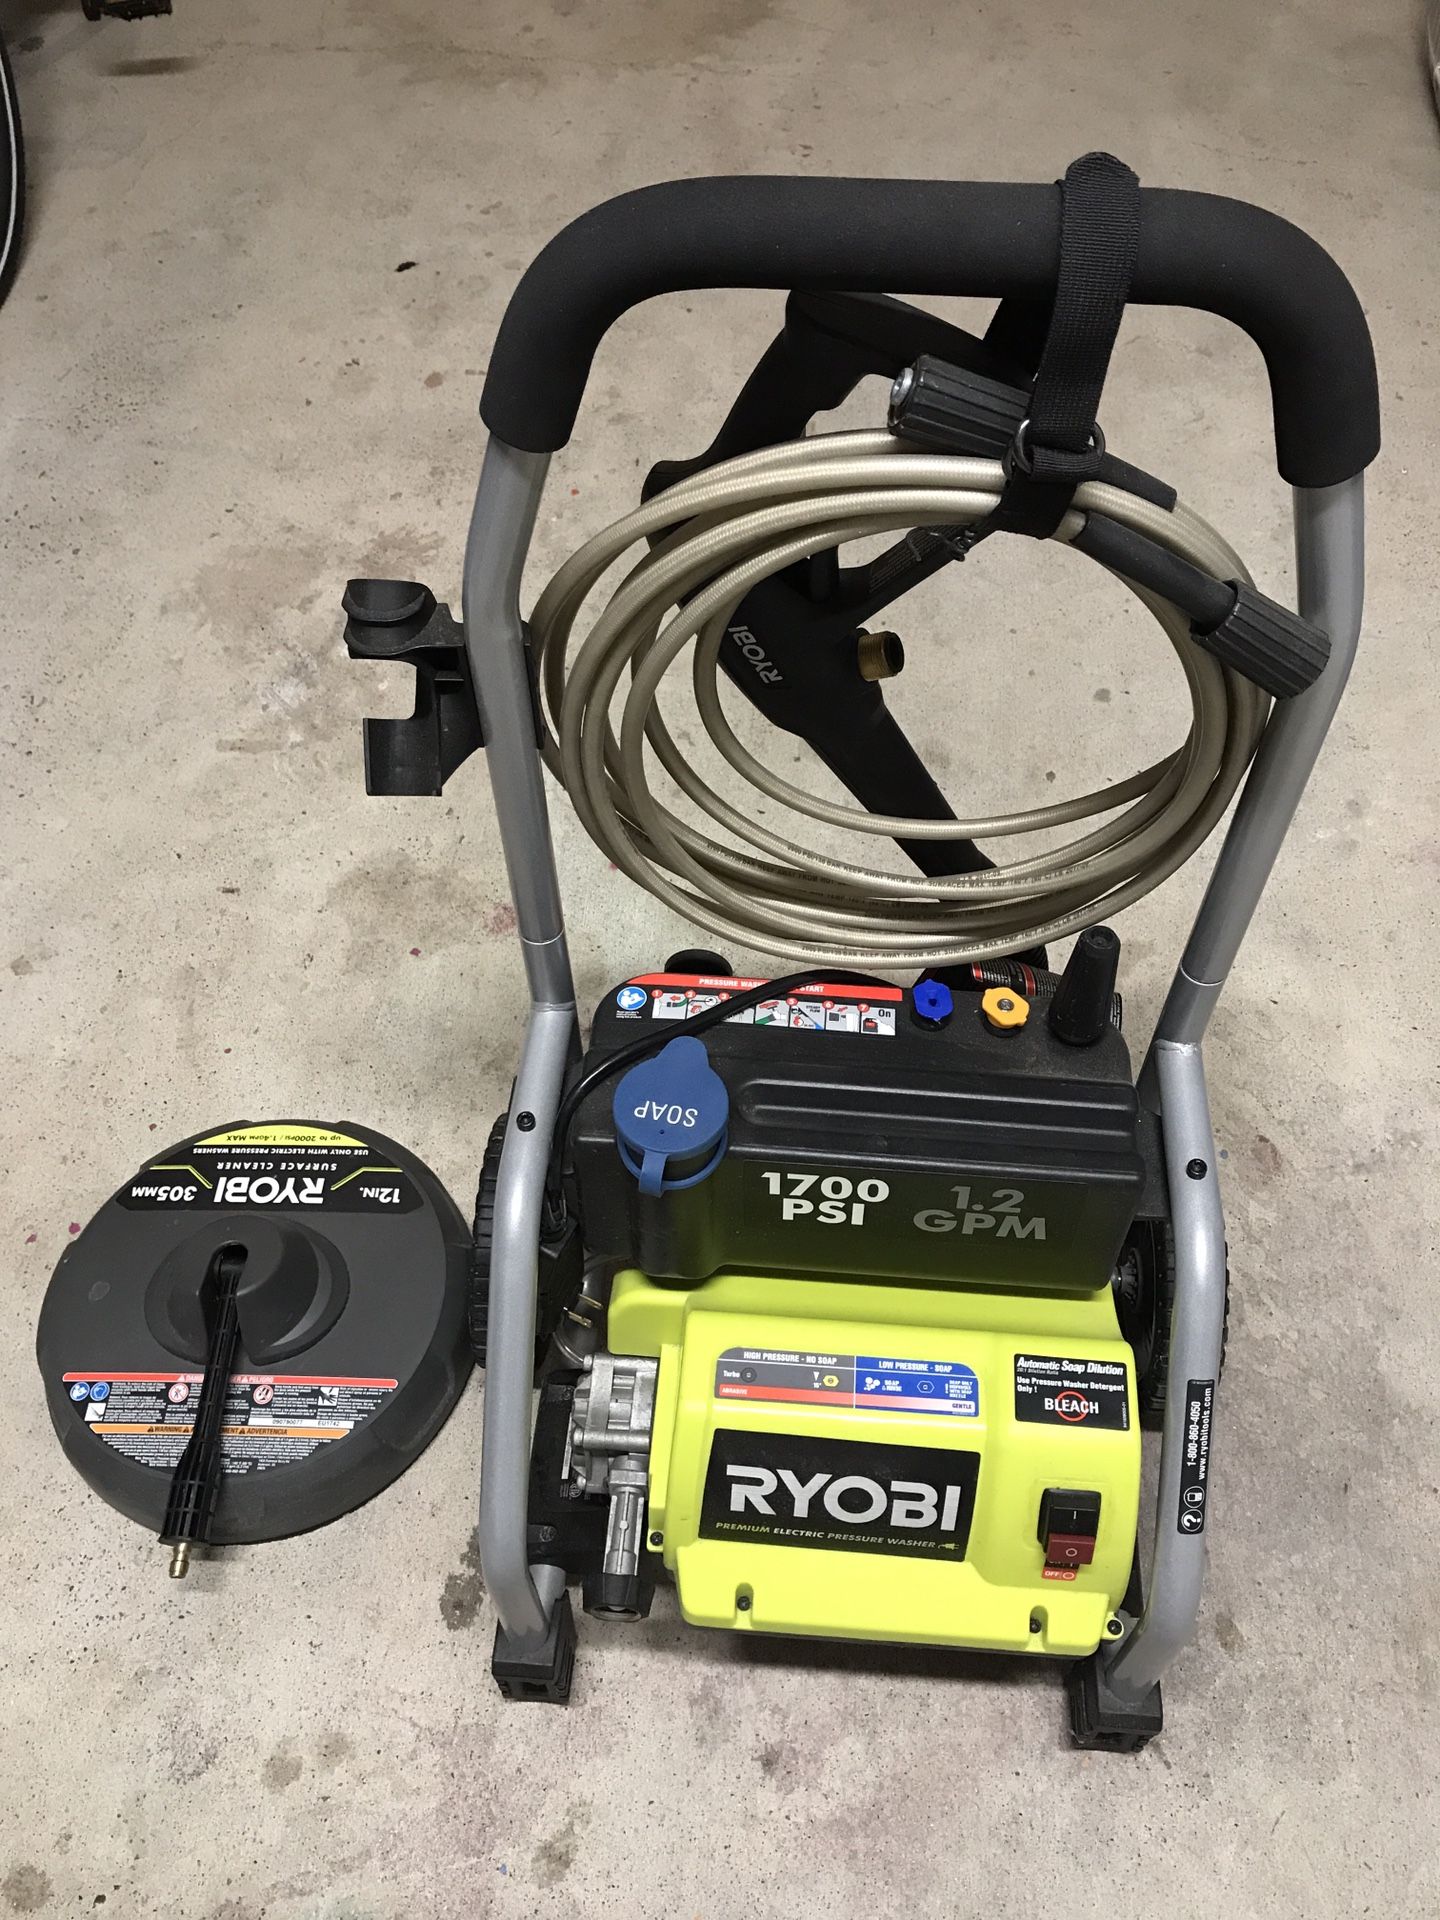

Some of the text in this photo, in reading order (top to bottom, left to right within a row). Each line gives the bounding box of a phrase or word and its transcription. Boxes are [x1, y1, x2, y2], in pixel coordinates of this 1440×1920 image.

[728, 625, 783, 683] RYOBI
[699, 978, 738, 987] PRESSURE
[878, 1009, 891, 1018] On
[634, 1100, 698, 1127] SOAP
[217, 1161, 337, 1171] SURFACE CLEANER
[131, 1176, 401, 1204] 12IN. RYOBI 305MM
[761, 1171, 890, 1202] 1700
[950, 1185, 1025, 1213] 1.2
[782, 1198, 865, 1226] PSI
[913, 1209, 1047, 1240] GPM
[743, 1351, 761, 1360] HIGH
[763, 1352, 800, 1362] PRESSURE
[806, 1355, 816, 1363] NO
[818, 1356, 837, 1365] SOAP
[879, 1361, 894, 1369] LOW
[895, 1361, 929, 1372] PRESSURE
[935, 1364, 953, 1373] SOAP
[1017, 1356, 1124, 1376] Automatic Soap Dilution
[723, 1370, 740, 1378] Turbo
[721, 1387, 748, 1395] ABRASIVE
[1017, 1376, 1125, 1393] Use Pressure Washer Detergent
[1017, 1384, 1033, 1394] Only
[1044, 1397, 1099, 1414] BLEACH
[1186, 1401, 1201, 1467] 1-800-860-4050
[1199, 1387, 1212, 1481] www.ryobitools.com
[726, 1464, 962, 1531] RYOBI
[715, 1522, 936, 1549] PREMIUM ELECTRIC PRESSURE WASHER
[1044, 1570, 1060, 1578] OFF
